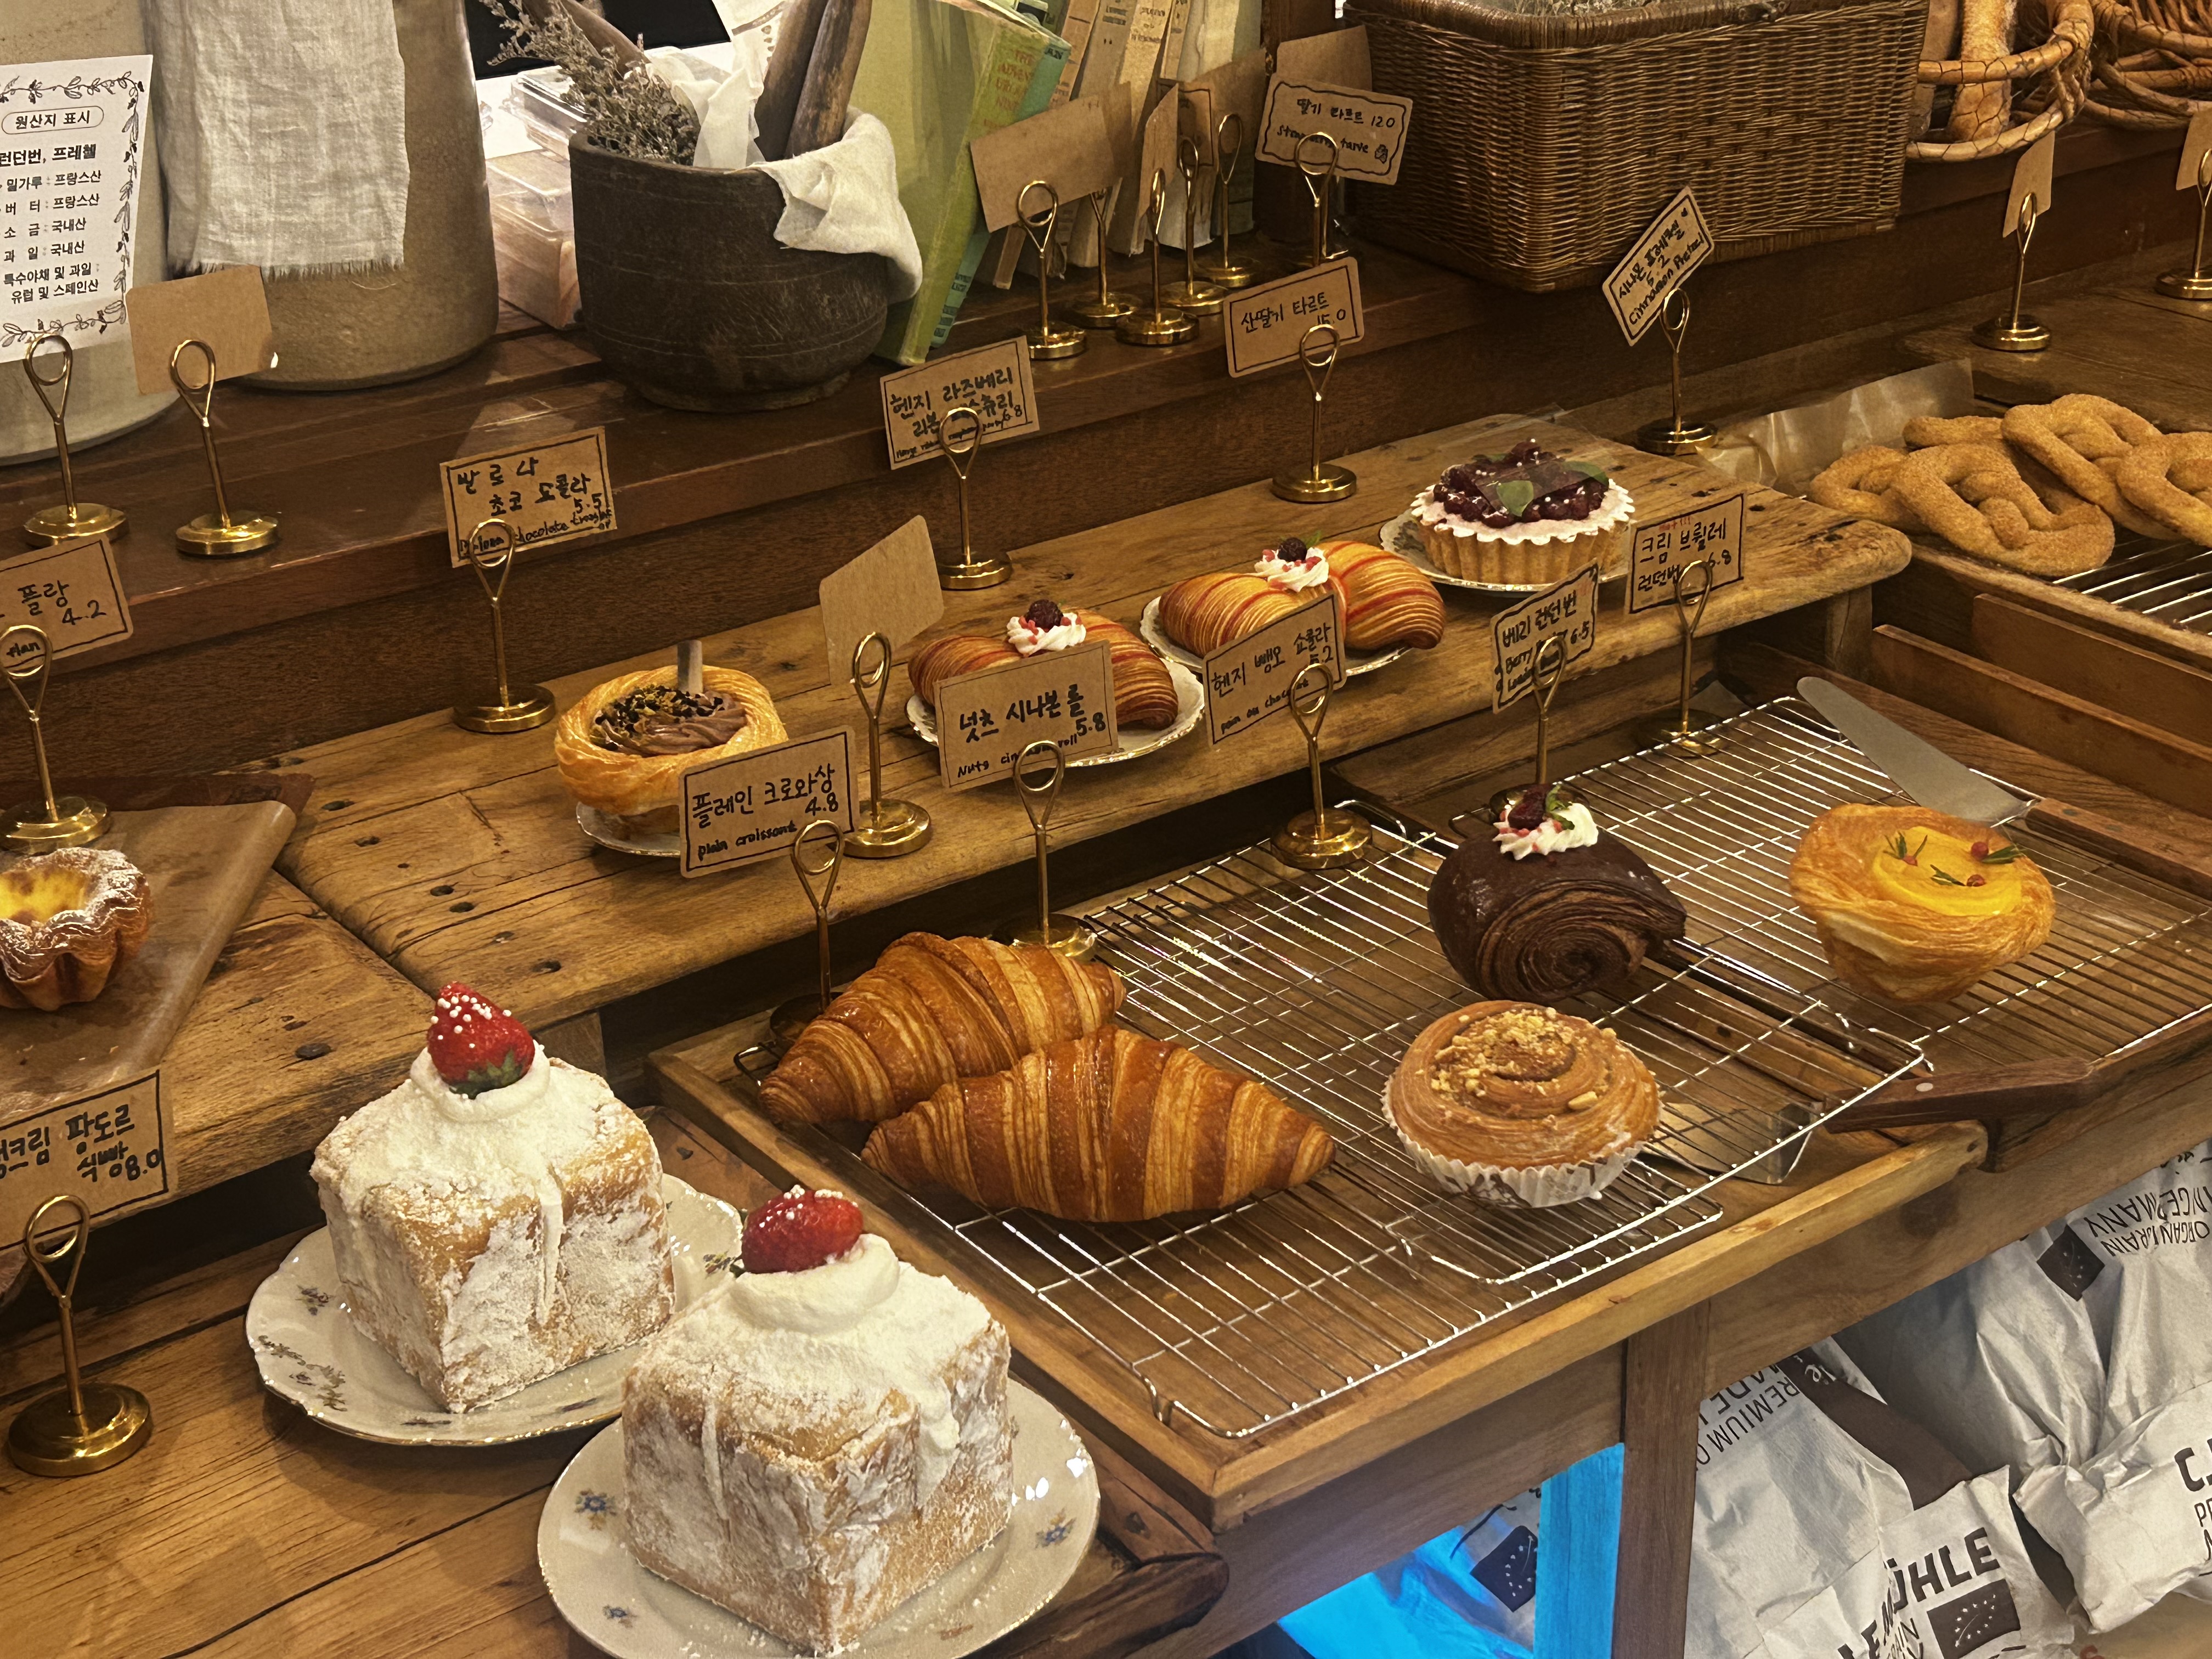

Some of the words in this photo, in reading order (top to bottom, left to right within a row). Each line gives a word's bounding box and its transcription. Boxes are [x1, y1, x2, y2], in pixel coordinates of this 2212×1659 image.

[15, 113, 57, 129] 원산지
[63, 110, 90, 124] 표시
[7, 176, 43, 192] 밀가루
[54, 170, 101, 185] 프랑스산
[53, 193, 100, 209] 프랑스산
[52, 217, 87, 233] 국내산
[50, 240, 84, 256] 국내산
[3, 268, 50, 287] 특수야채
[54, 266, 65, 280] 및
[69, 262, 92, 277] 과일
[11, 288, 33, 304] 유럽
[38, 286, 50, 300] 및
[53, 279, 99, 297] 스페인산
[1241, 303, 1284, 334] 산딸기
[1293, 292, 1329, 315] 타르트
[573, 493, 602, 514] 5.5
[1640, 532, 1672, 565] 크림
[18, 580, 70, 616] 플랑
[960, 709, 1000, 743] 넛츠
[1076, 712, 1106, 736] 5.8
[692, 786, 754, 828] 플레인
[764, 763, 835, 805] 크로와상
[805, 792, 839, 816] 4.8
[698, 839, 729, 861] plain
[65, 1104, 135, 1154] 팡도르
